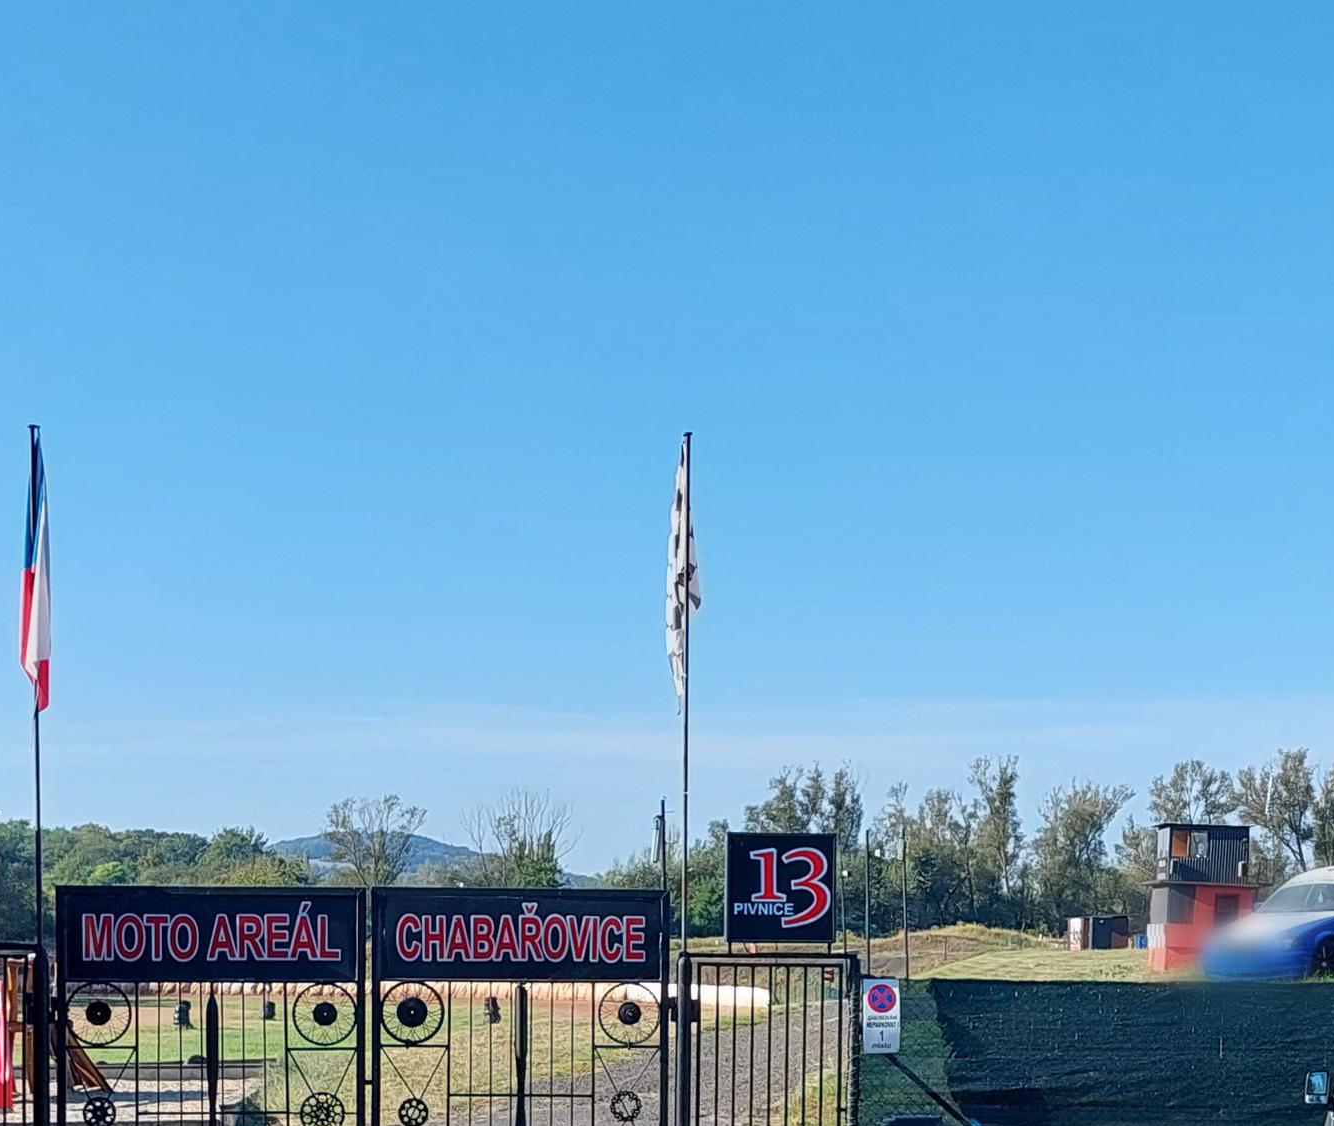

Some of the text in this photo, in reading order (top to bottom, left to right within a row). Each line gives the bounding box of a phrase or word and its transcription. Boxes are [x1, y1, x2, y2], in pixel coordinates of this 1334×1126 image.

[733, 902, 794, 916] PIVNICE
[749, 847, 832, 929] 13
[81, 902, 342, 962] MOTO AREÁL
[396, 903, 647, 963] CHABAŘOVICE
[879, 1030, 884, 1041] 1
